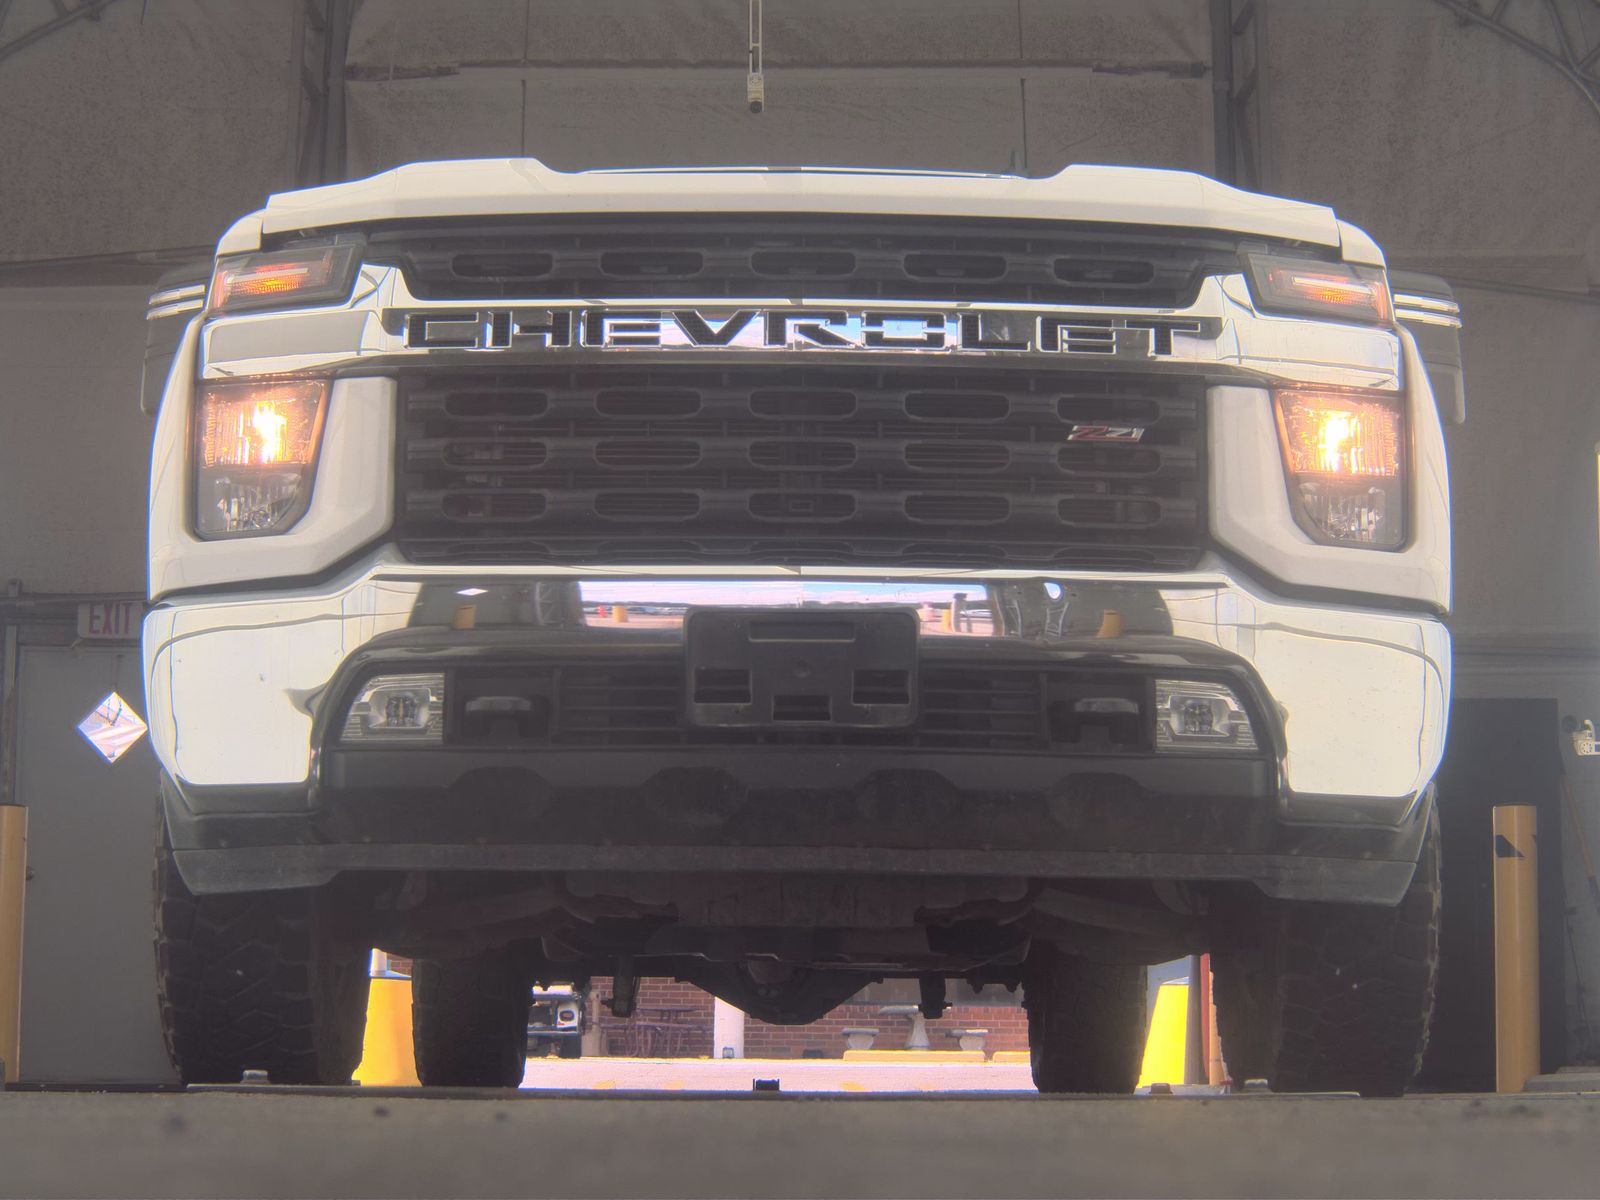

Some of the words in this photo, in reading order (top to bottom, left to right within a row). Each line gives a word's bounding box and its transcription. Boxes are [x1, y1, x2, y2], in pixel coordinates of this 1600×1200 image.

[404, 309, 1200, 356] CHEVROLET
[1067, 425, 1144, 442] Z71
[88, 603, 133, 635] EXIT
